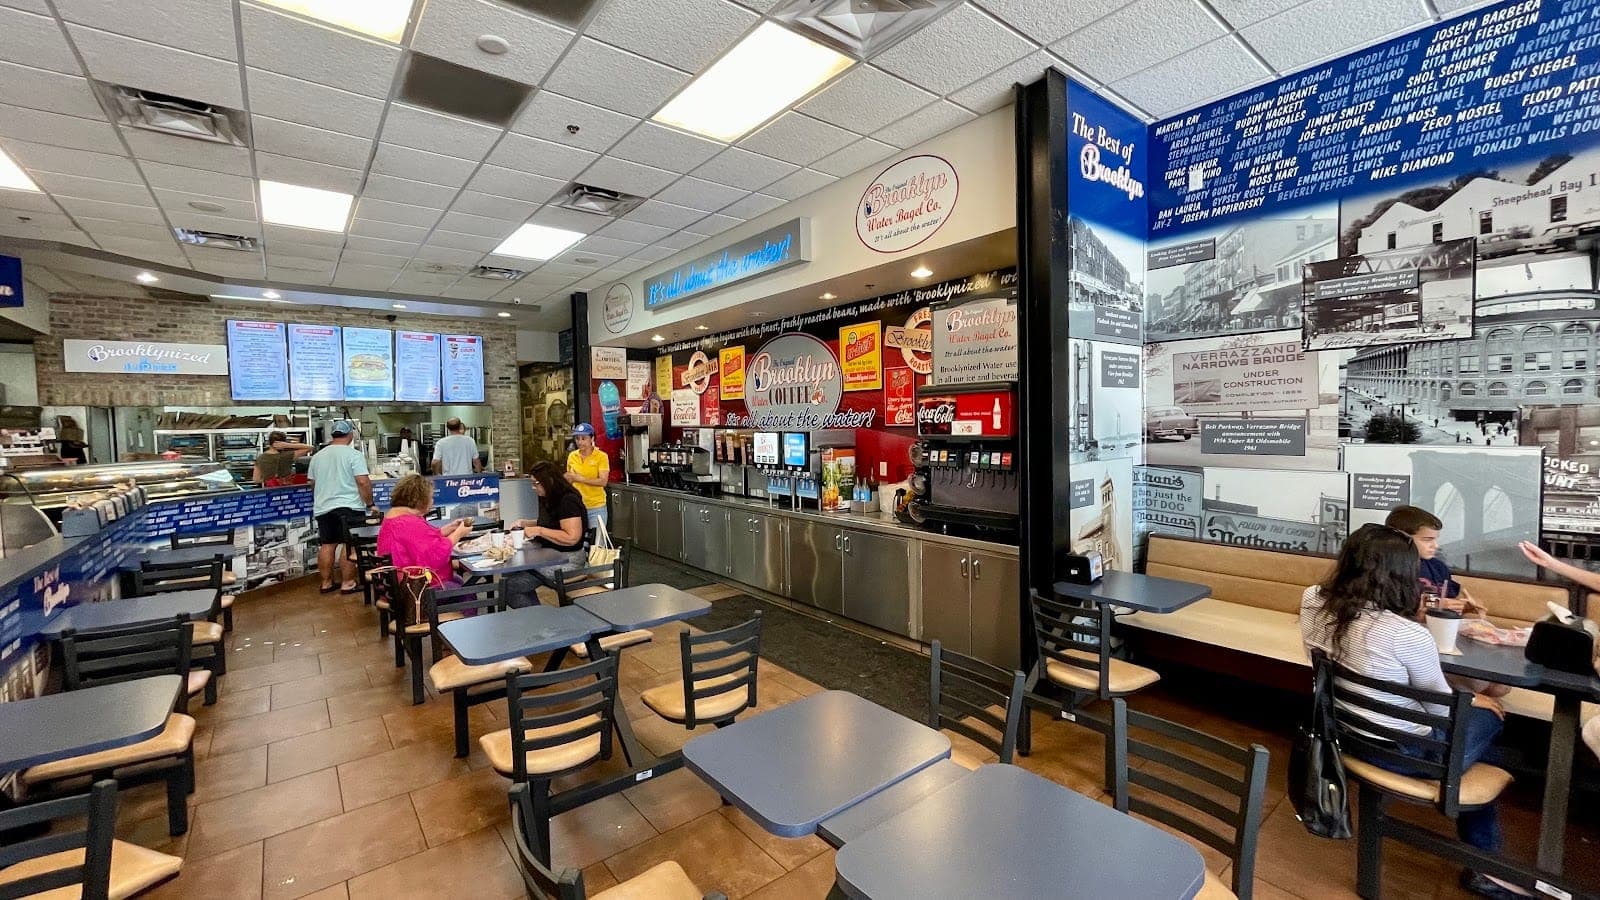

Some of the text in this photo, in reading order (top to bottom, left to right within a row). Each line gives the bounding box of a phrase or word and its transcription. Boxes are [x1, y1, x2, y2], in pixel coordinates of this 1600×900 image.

[1426, 12, 1539, 57] HARVEY FIERSTEIN
[1432, 18, 1477, 43] JOSEPH
[1481, 0, 1541, 26] BARBERA
[1538, 9, 1586, 35] DANNY
[1348, 38, 1421, 72] WOODY ALLEN
[1421, 32, 1518, 71] RITA HAYWORTH
[1516, 29, 1570, 55] ARTHUR
[1333, 54, 1409, 87] LOU FERRIGNO
[1406, 50, 1498, 88] SHOL SCHUMER
[1511, 45, 1561, 71] HARVEY
[1278, 67, 1332, 95] MAX ROACH
[1391, 66, 1492, 104] MICHAEL JORDAN
[1484, 54, 1578, 90] BUGSY SIEGEL
[1317, 68, 1404, 103] SUSAN HAYWARD
[1483, 76, 1550, 103] PERELMAN
[1522, 86, 1562, 106] FLOYD
[1228, 92, 1265, 112] RICHARD
[1246, 84, 1318, 116] JIMMY DURANTE
[1320, 84, 1391, 114] STEVE RUBELL
[1381, 86, 1465, 119] JIMMY KIMMEL
[1522, 96, 1574, 120] JOSEPH
[1155, 113, 1201, 136] MARTHA RAY
[1235, 99, 1304, 130] BUDDY HACKETT
[1243, 110, 1307, 138] ESAI MORALES
[1305, 100, 1376, 130] JIMMY SMITTS
[1360, 106, 1439, 137] ARNOLD MOSS
[1421, 101, 1502, 132] ZERO MOSTEL
[1072, 112, 1134, 165] The Best of
[1170, 126, 1223, 150] ARLO GUTHRIE
[1236, 126, 1292, 150] LARRY DAVID
[1298, 114, 1367, 143] JOE PEPITONE
[1417, 114, 1504, 145] JAMIE HECTOR
[1447, 120, 1532, 150] LICHTENSTEIN
[1473, 125, 1568, 157] DONALD WILLS
[1168, 134, 1231, 161] STEPHANIE MILLS
[1297, 132, 1346, 154] FABOLOUS
[1311, 131, 1393, 161] MARTIN LANDAU
[1312, 140, 1402, 172] CONNIE HAWKINS
[1081, 143, 1144, 201] Brooklyn
[1164, 167, 1186, 180] TUPAC
[1232, 150, 1283, 172] ANN MEARA
[1249, 156, 1297, 178] ALAN KING
[1297, 157, 1385, 186] EMMANUEL LEWIS
[1370, 151, 1455, 181] MIKE DIAMOND
[1168, 176, 1186, 189] PAUL
[1243, 181, 1284, 199] ROSE LEE
[1249, 166, 1300, 188] MOSS HART
[1319, 175, 1356, 193] PEPPER
[864, 172, 947, 218] Brooklyn
[1184, 189, 1210, 203] MORTY
[1492, 180, 1583, 208] Sheepshead Bay
[867, 199, 941, 232] Water Bagel Co.
[1175, 202, 1201, 215] LAURIA
[1181, 209, 1209, 224] JOSEPH
[1152, 219, 1172, 230] JAY-Z
[648, 232, 792, 305] It's all about the water!
[736, 327, 749, 339] with
[750, 326, 760, 335] the
[781, 315, 803, 333] freshly
[804, 308, 832, 325] roasted
[832, 305, 858, 319] beans,
[860, 299, 885, 313] made
[887, 291, 912, 308] with
[945, 308, 1017, 332] Brooklyn
[999, 327, 1011, 338] Co.
[87, 344, 210, 363] Brooklynized
[963, 348, 981, 357] about
[1182, 352, 1306, 371] NARROWS BRIDGE
[1190, 344, 1296, 362] VERRAZZANO
[754, 352, 835, 392] Brooklyn
[940, 361, 1003, 374] Brooklynized Water
[1243, 369, 1279, 378] UNDER
[1223, 377, 1303, 389] CONSTRUCTION
[741, 411, 757, 428] all
[761, 409, 796, 430] about
[798, 407, 821, 429] the
[823, 408, 876, 431] water!
[895, 409, 913, 424] Coke
[458, 486, 498, 497] Brooklyn
[476, 478, 485, 486] of
[1155, 489, 1173, 499] just
[1177, 493, 1192, 503] the
[1161, 500, 1185, 511] DOG
[1208, 528, 1309, 552] Nathan's
[1286, 527, 1316, 538] CROWD
